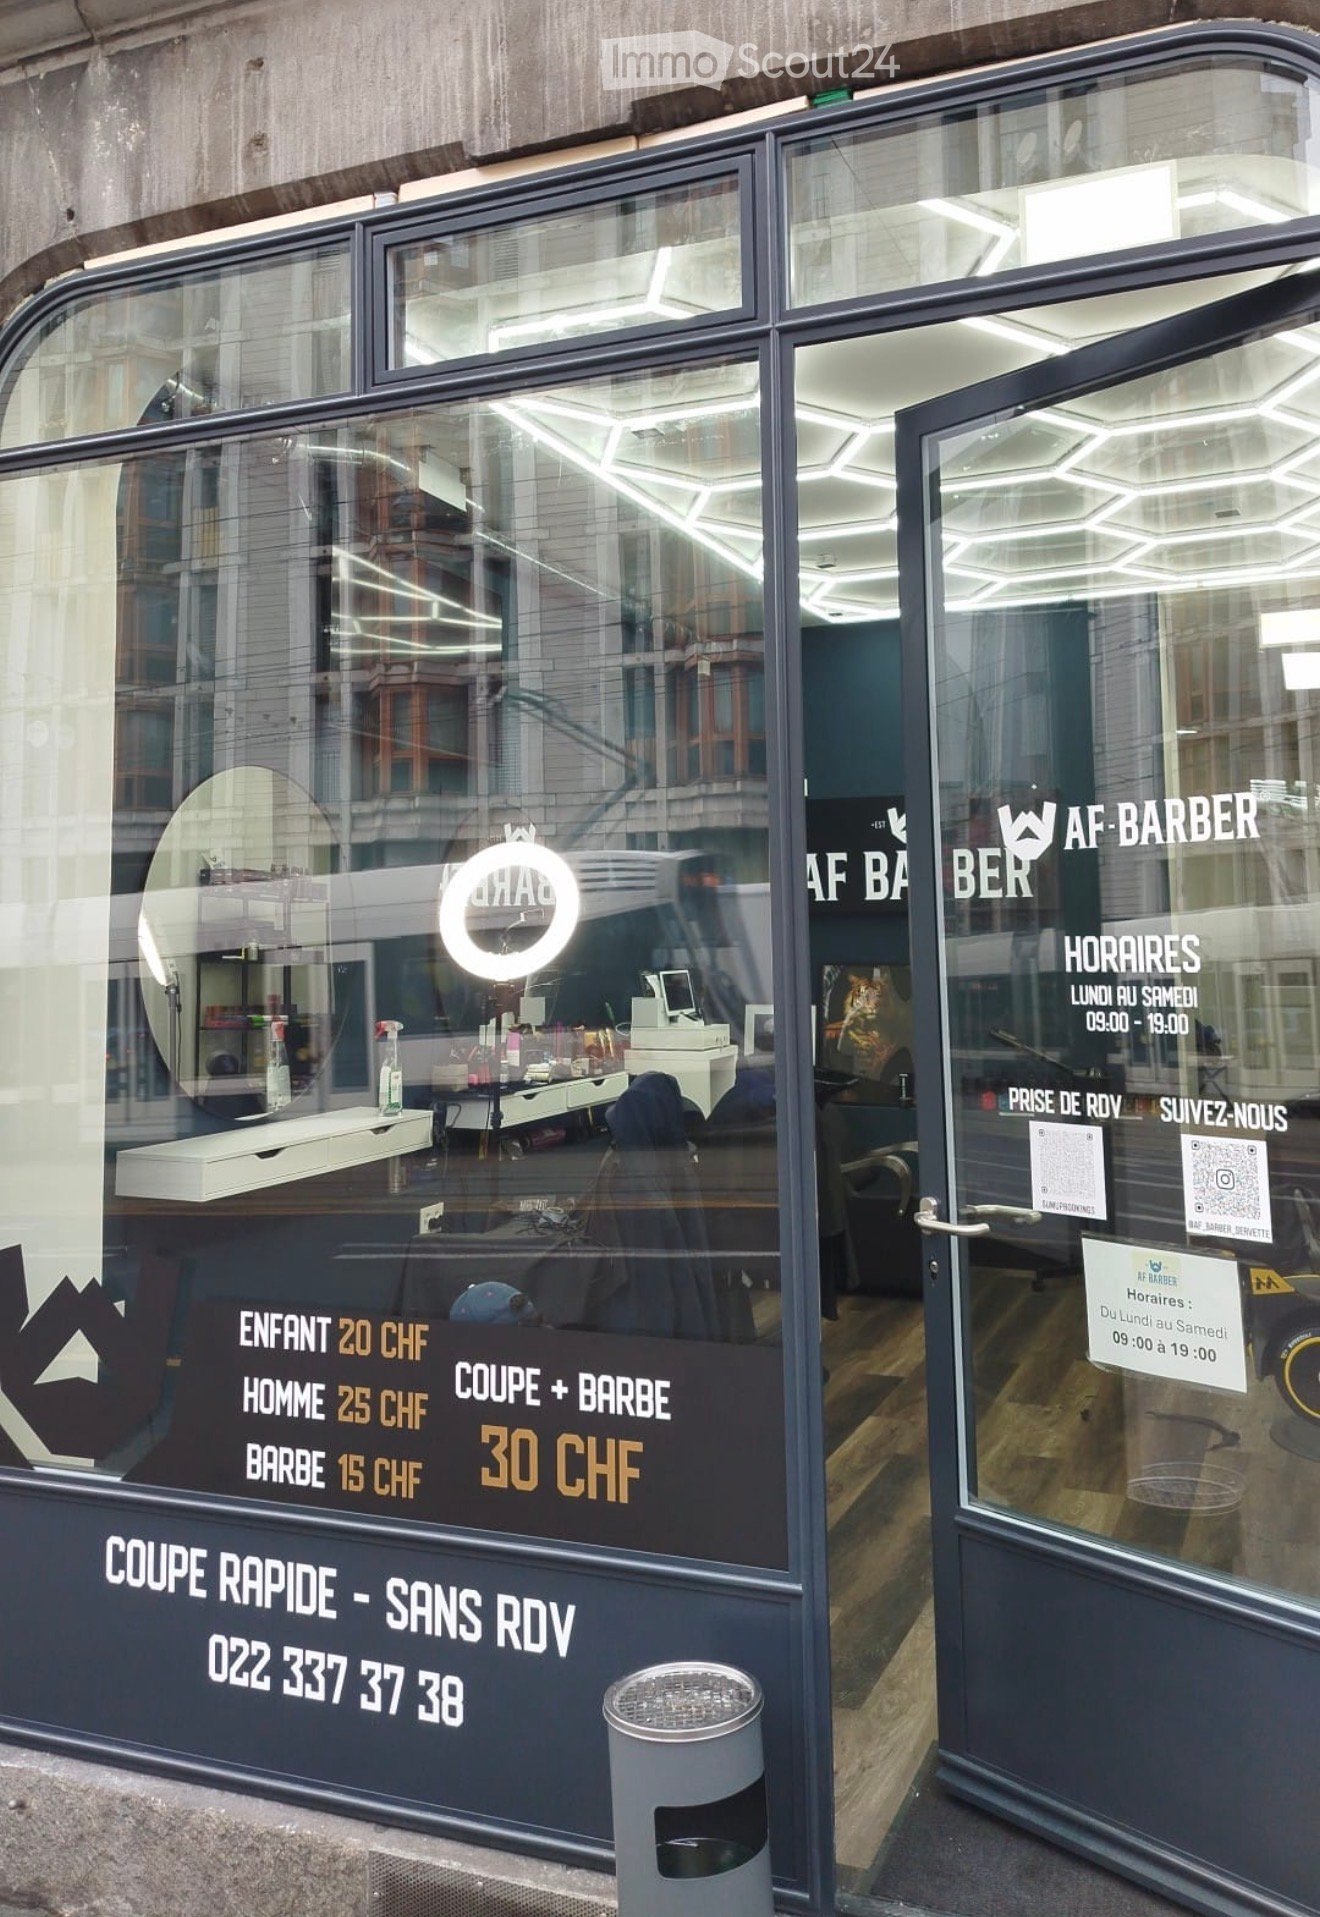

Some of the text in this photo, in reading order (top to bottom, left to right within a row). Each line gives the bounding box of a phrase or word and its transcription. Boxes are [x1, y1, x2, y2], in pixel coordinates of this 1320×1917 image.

[1064, 791, 1261, 850] AF-BARBER
[806, 852, 848, 901] AF
[1064, 934, 1201, 973] HORAIRES
[1071, 984, 1198, 1008] LUNDI AU SAMEDI
[1086, 1011, 1129, 1033] 09:00
[1149, 1012, 1189, 1035] 19:00
[1008, 1087, 1122, 1119] PRISE DE RDV
[1159, 1096, 1288, 1132] SUIVEZ-NOUS
[1100, 1305, 1228, 1340] Du Lundi au Samedi
[1127, 1288, 1185, 1309] Horaires
[239, 1310, 429, 1361] ENFANT 20 CHF
[1157, 1338, 1166, 1354] à
[242, 1376, 428, 1430] HOMME 25 CHF
[454, 1361, 671, 1420] COUPE + BARBE
[245, 1442, 423, 1499] BARBE 15 CHF
[481, 1424, 644, 1504] 30 CHF
[105, 1535, 208, 1599] COUPE
[219, 1551, 338, 1620] RAPIDE
[385, 1577, 483, 1644] SANS
[497, 1593, 576, 1658] RDV
[208, 1633, 464, 1728] 022 337 37 38
